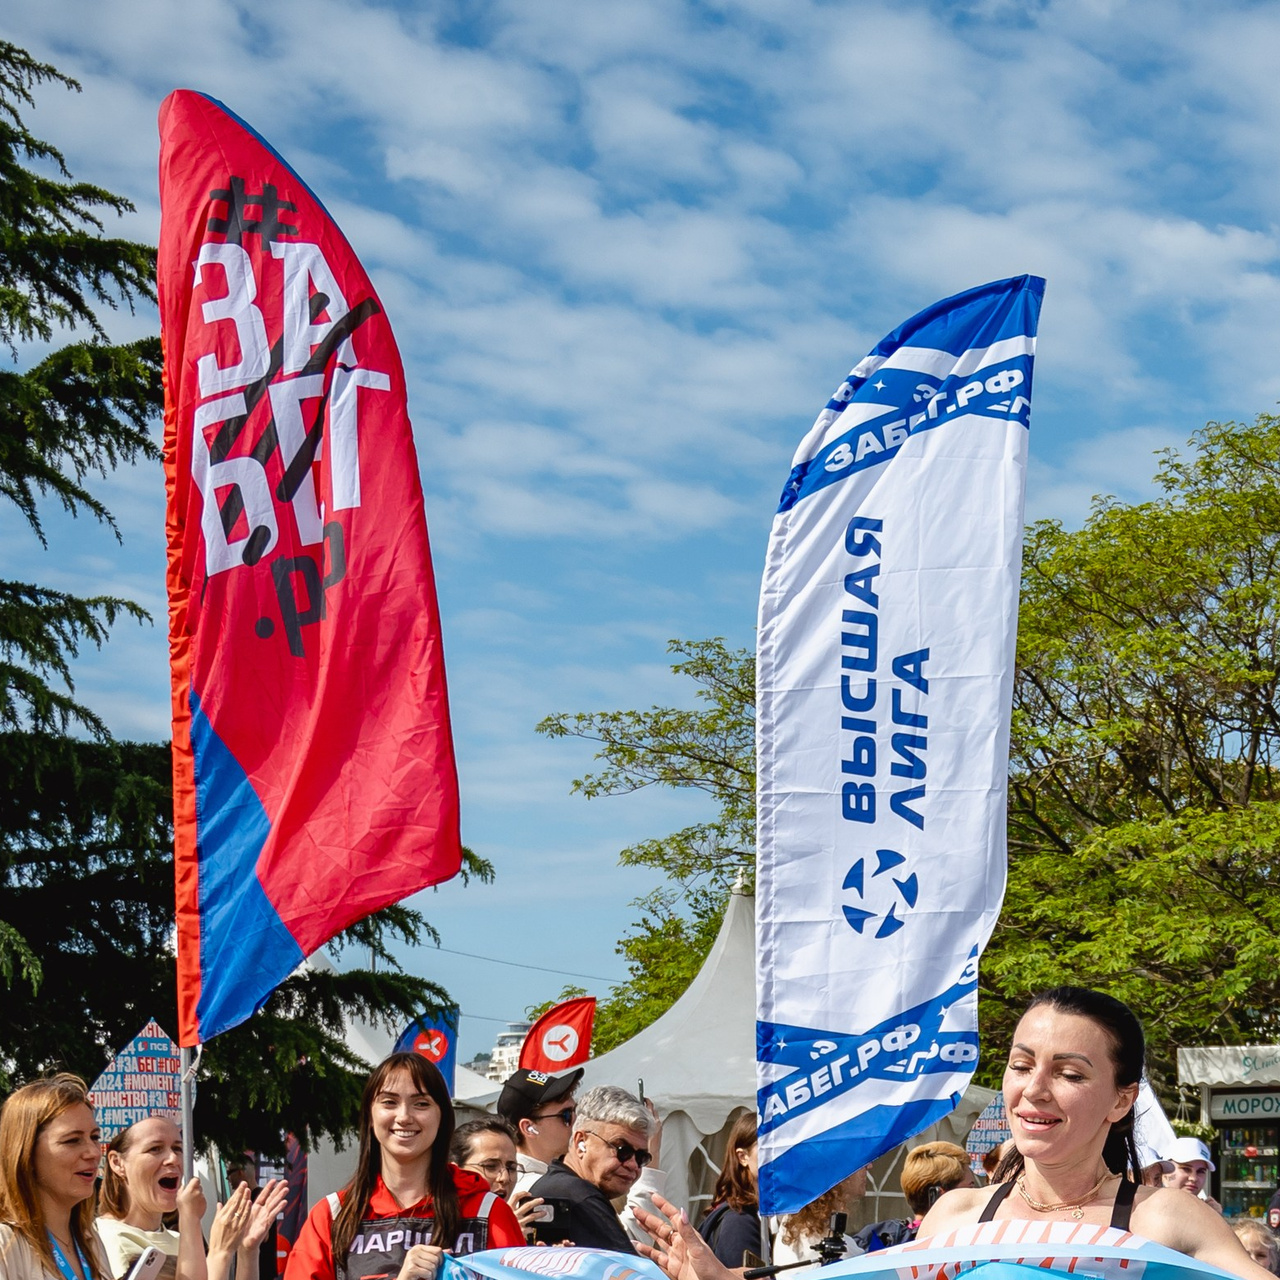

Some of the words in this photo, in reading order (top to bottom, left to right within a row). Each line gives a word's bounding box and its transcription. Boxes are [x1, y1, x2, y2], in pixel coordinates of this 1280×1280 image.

[840, 516, 884, 824] ВЫСШАЯ
[889, 647, 930, 831] ЛИГА
[123, 1074, 174, 1091] #МОМЕНТ
